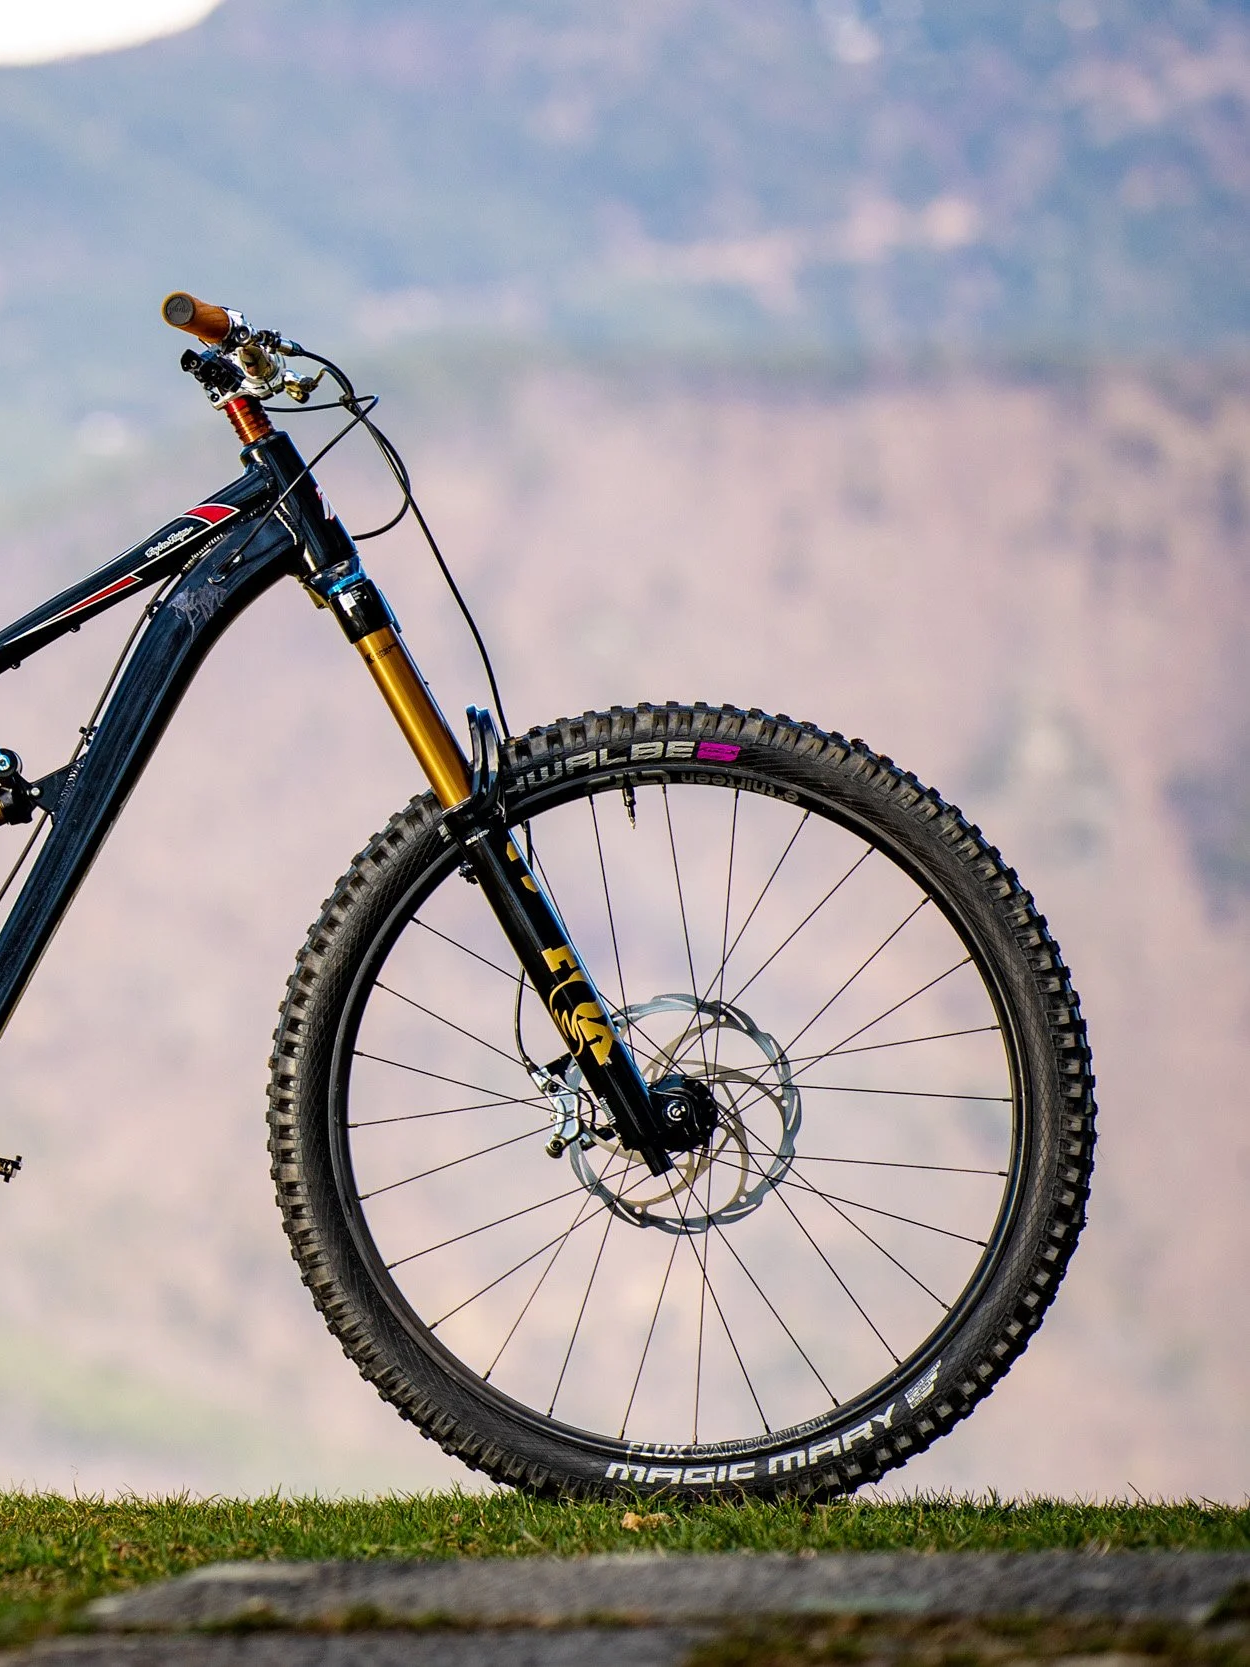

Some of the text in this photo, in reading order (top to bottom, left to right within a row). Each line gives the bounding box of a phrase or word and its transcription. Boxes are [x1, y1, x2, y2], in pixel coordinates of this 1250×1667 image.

[605, 1402, 897, 1485] MAGIC MARY
[626, 1441, 688, 1460] FLUX
[690, 1428, 796, 1459] CARBON
